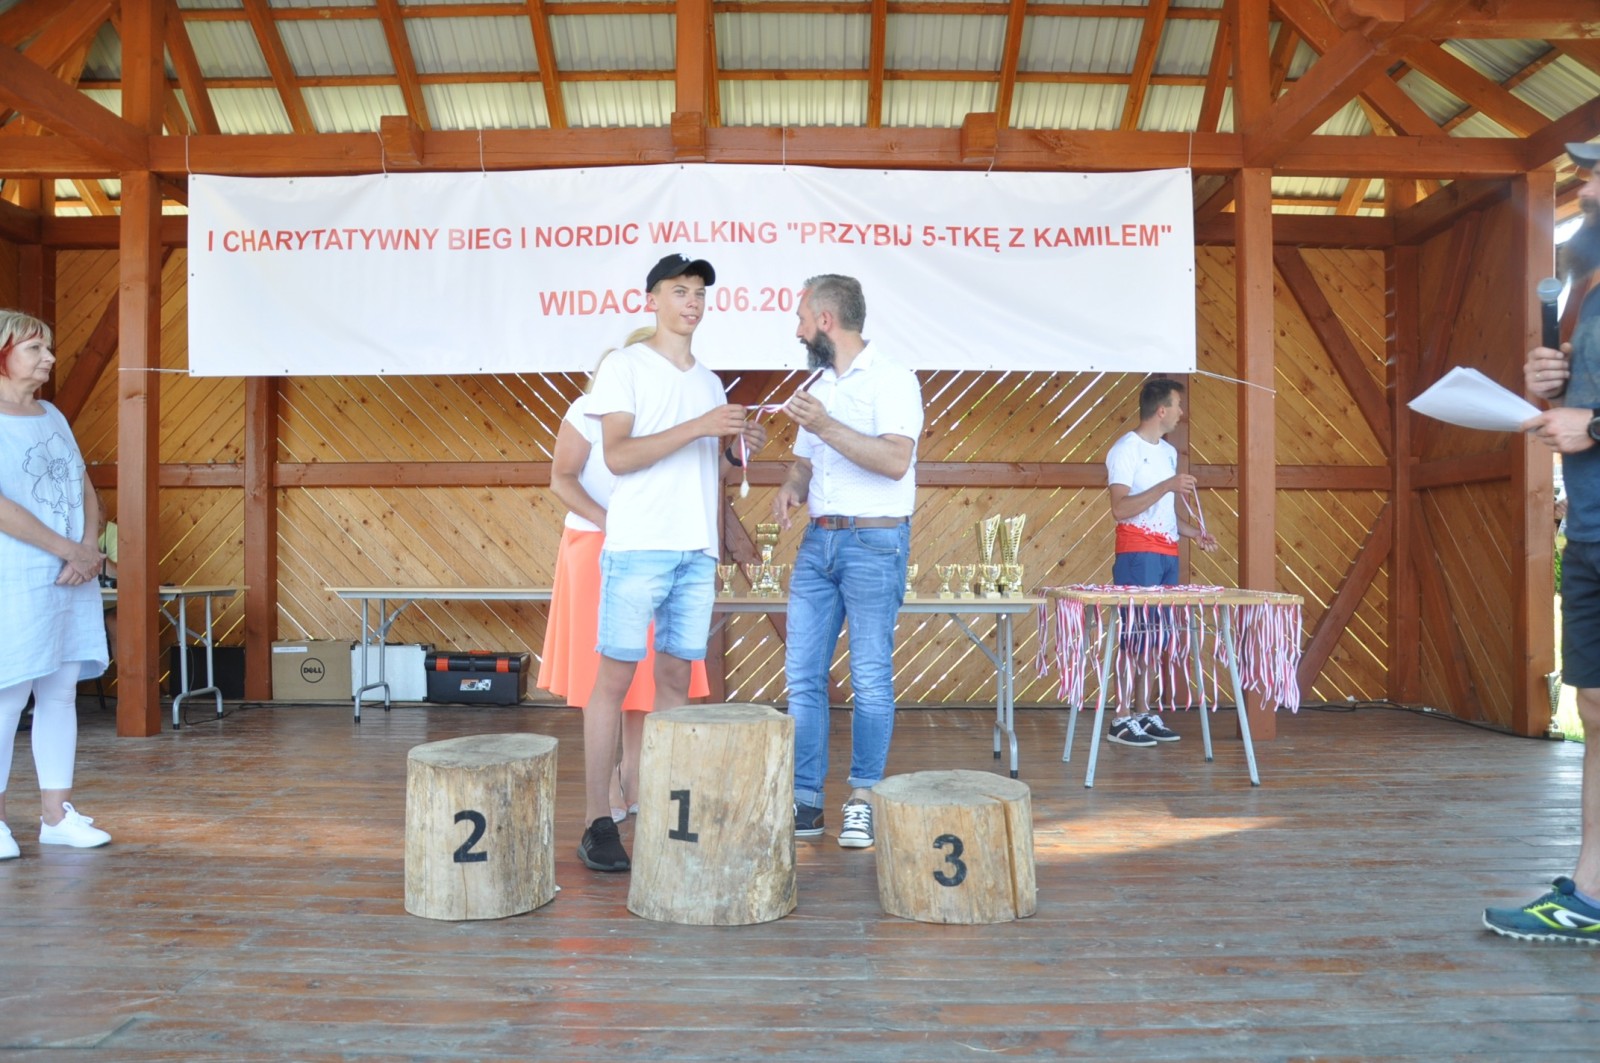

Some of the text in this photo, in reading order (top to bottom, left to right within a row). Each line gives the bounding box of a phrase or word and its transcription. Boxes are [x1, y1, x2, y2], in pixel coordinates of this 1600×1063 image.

[208, 221, 1173, 253] I CHARYTATYWNY BIEG I NORDIC WALKING "PRZYBIJ 5-TKĘ Z KAMILEM"
[452, 809, 488, 863] 2
[669, 789, 700, 844] 1
[932, 833, 968, 887] 3
